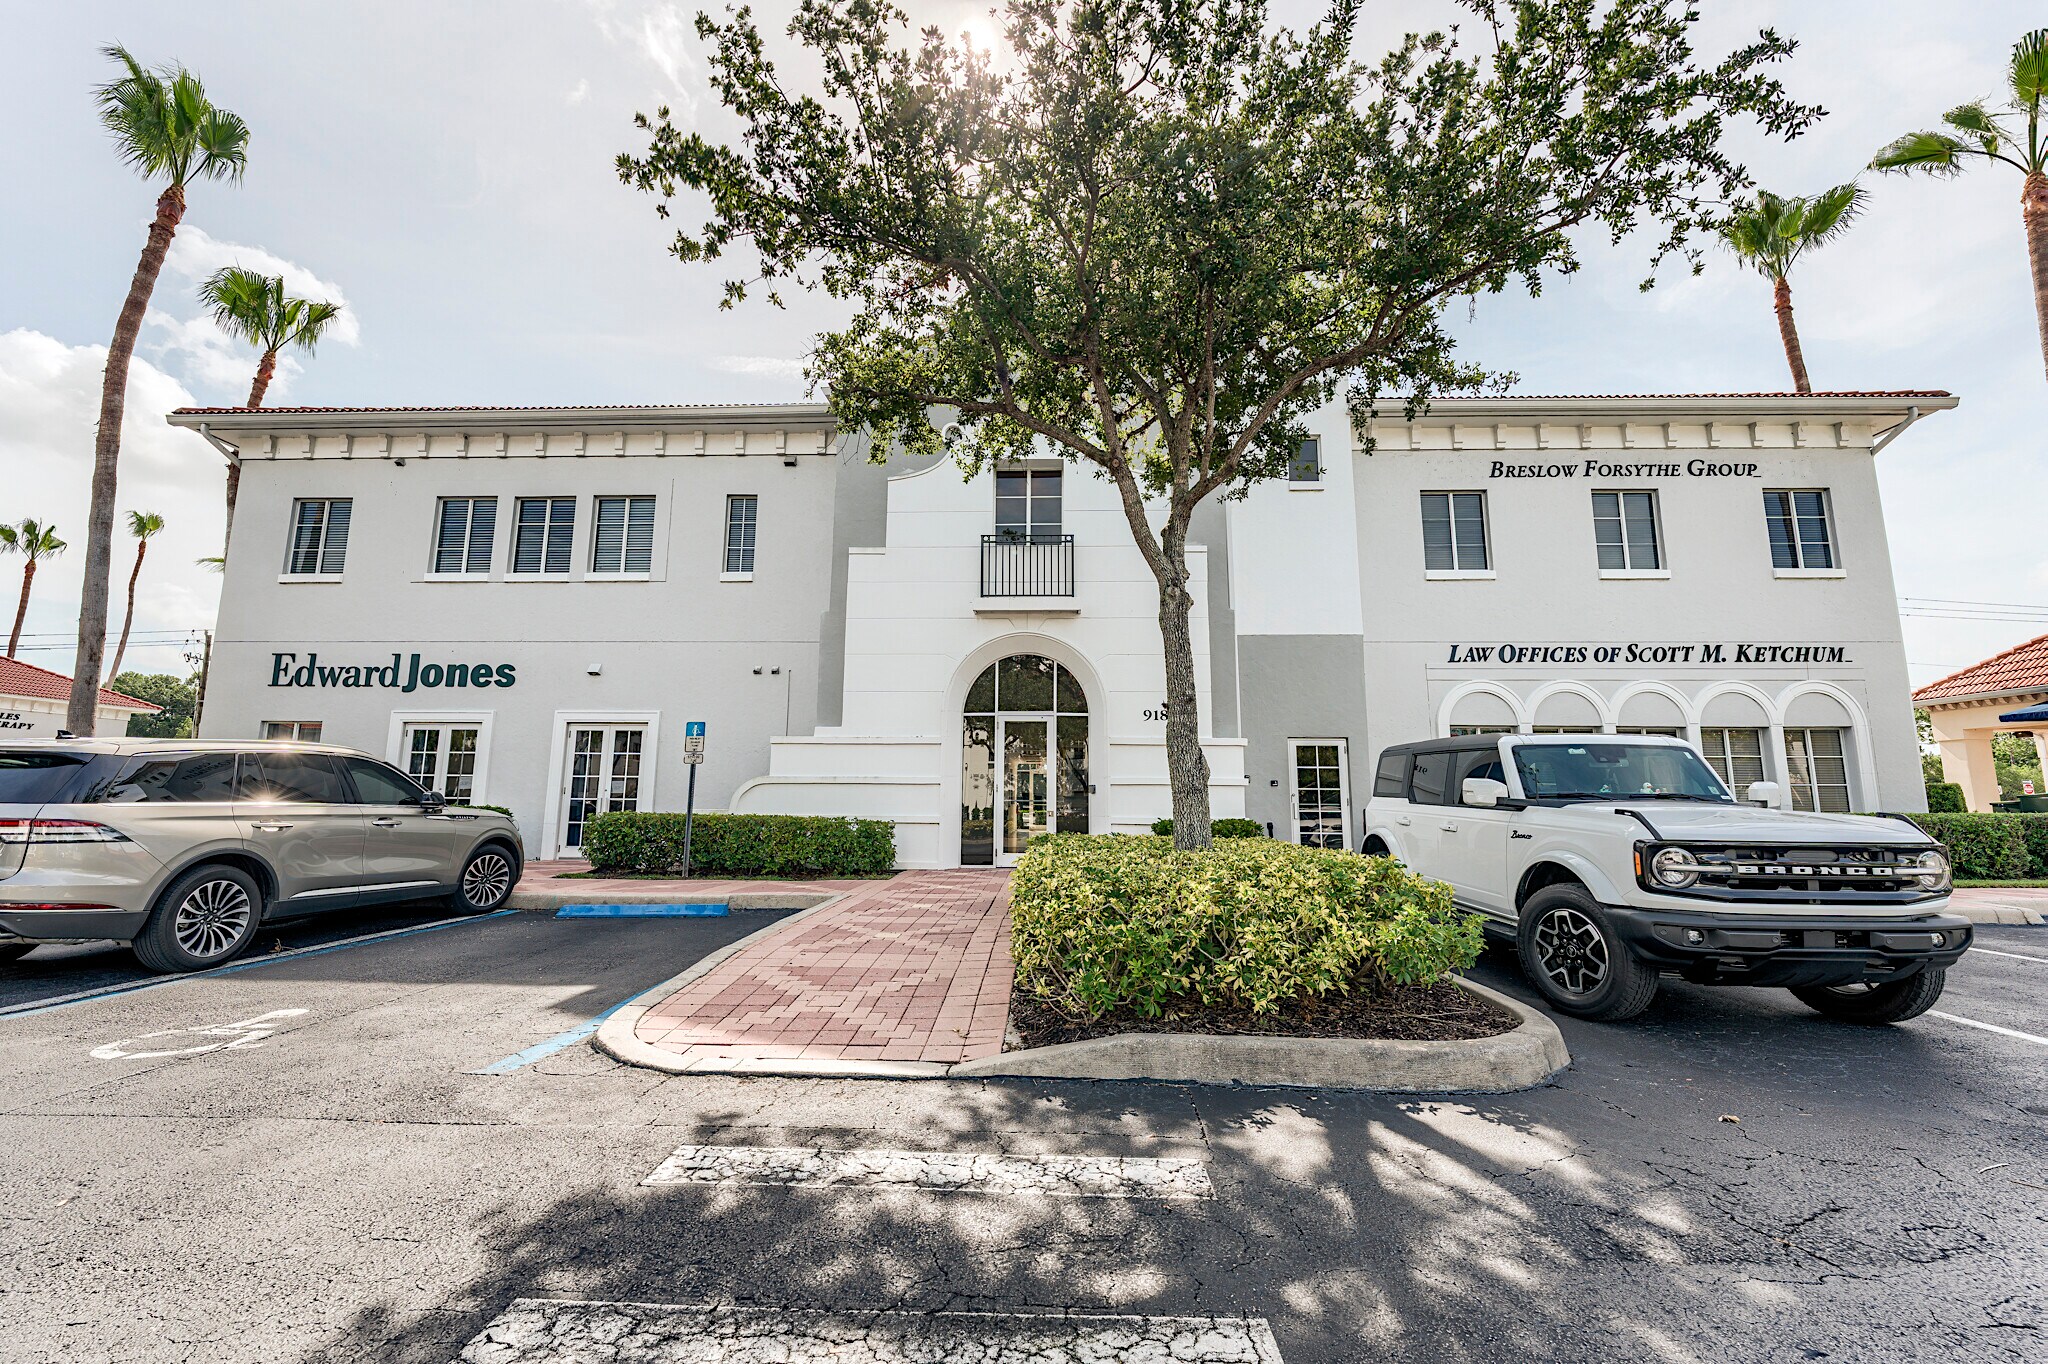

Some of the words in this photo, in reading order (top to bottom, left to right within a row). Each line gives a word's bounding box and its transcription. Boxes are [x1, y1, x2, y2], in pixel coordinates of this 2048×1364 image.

[1489, 460, 1578, 478] BRESLOW
[1583, 460, 1681, 477] FORSYTHE
[1687, 459, 1758, 477] GROUP
[1448, 644, 1495, 663] LAW
[1499, 643, 1588, 664] OFFICES
[1593, 646, 1622, 663] OF
[1625, 643, 1695, 663] SCOTT
[1699, 644, 1727, 664] M.
[1734, 644, 1845, 663] KETCHUM
[268, 652, 401, 688] Edward
[401, 653, 516, 693] Jones
[0, 721, 35, 730] RAPY
[1737, 865, 1893, 876] BRONCO
